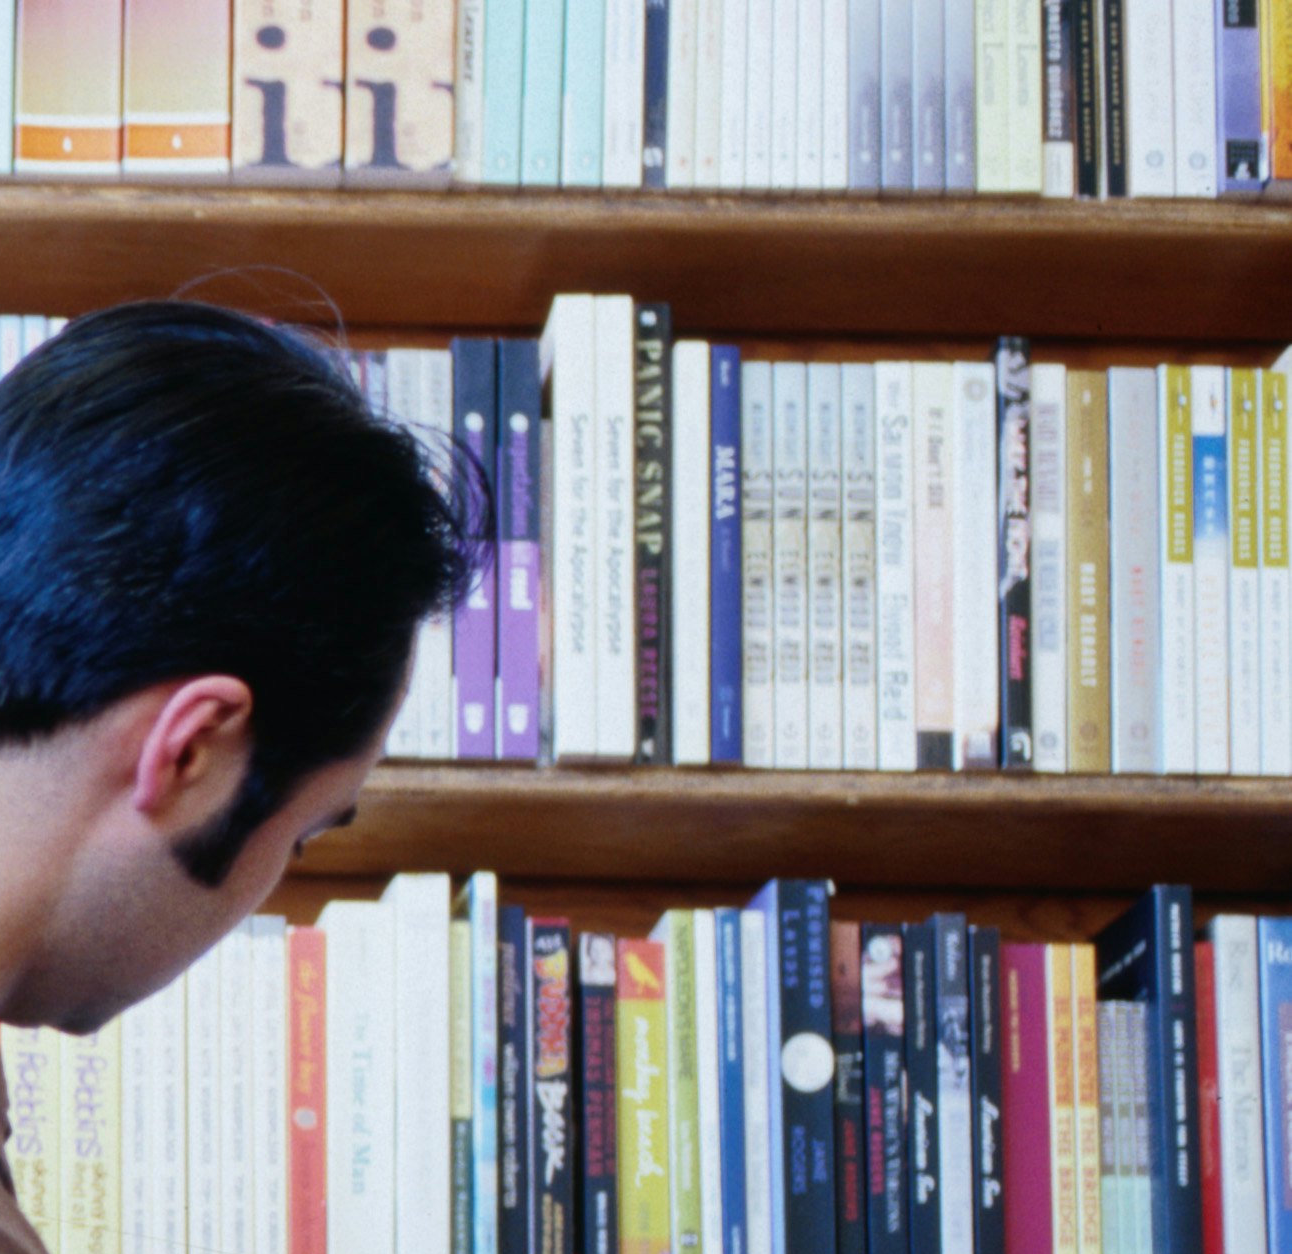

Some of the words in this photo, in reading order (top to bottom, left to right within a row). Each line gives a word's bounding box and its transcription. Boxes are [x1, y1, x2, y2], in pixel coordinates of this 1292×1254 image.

[635, 339, 665, 448] PANIC
[635, 460, 665, 555] SNAP
[715, 444, 736, 521] MARA
[569, 506, 588, 539] the
[606, 508, 625, 541] the
[73, 1054, 109, 1159] Robbins
[352, 1143, 374, 1196] Man
